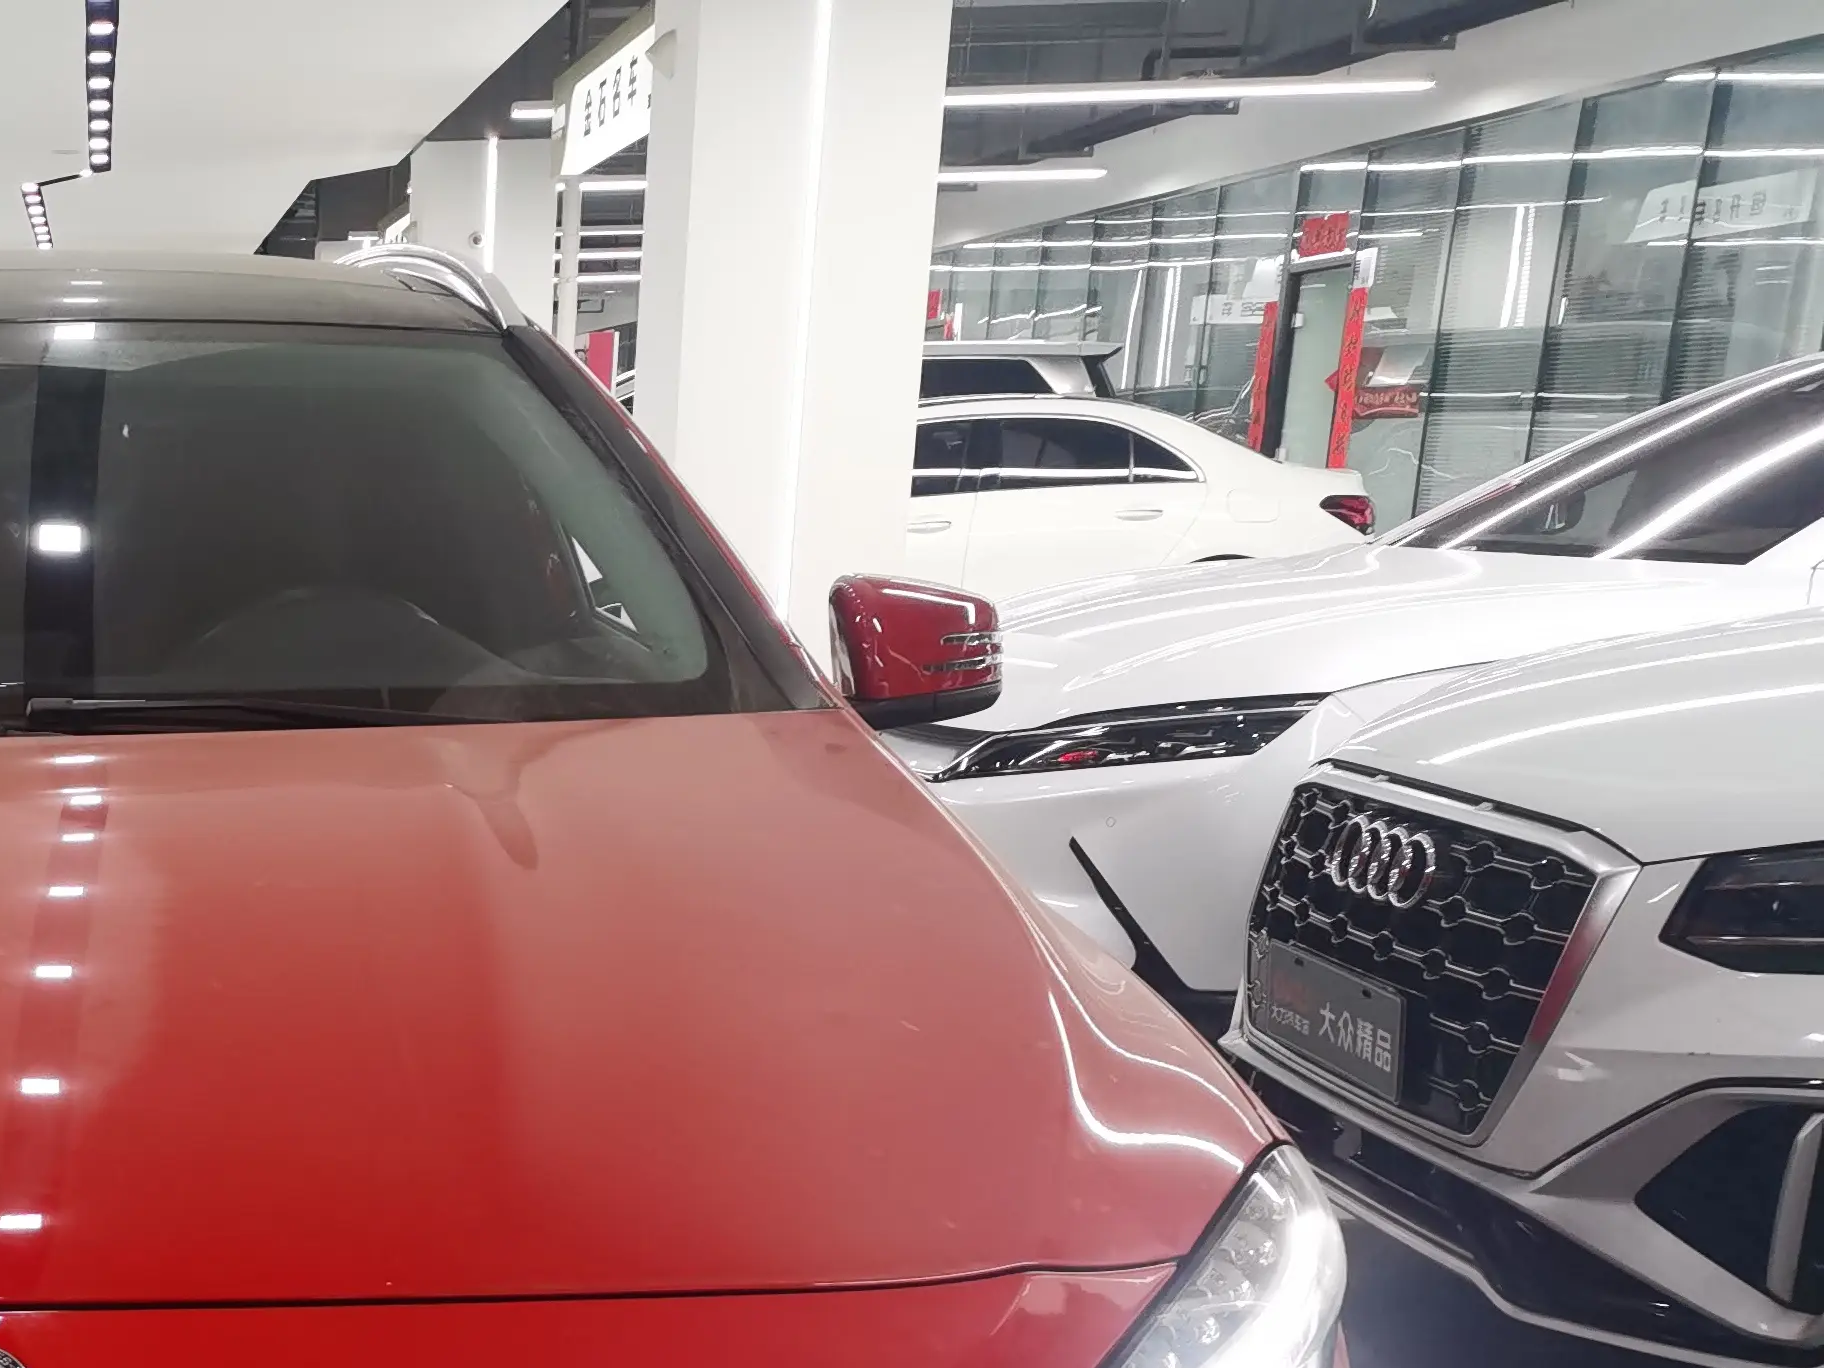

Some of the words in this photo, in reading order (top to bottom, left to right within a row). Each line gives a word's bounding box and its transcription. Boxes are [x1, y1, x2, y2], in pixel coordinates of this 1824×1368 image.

[583, 54, 638, 136] 金石名车
[1318, 1001, 1392, 1072] 大众精品
